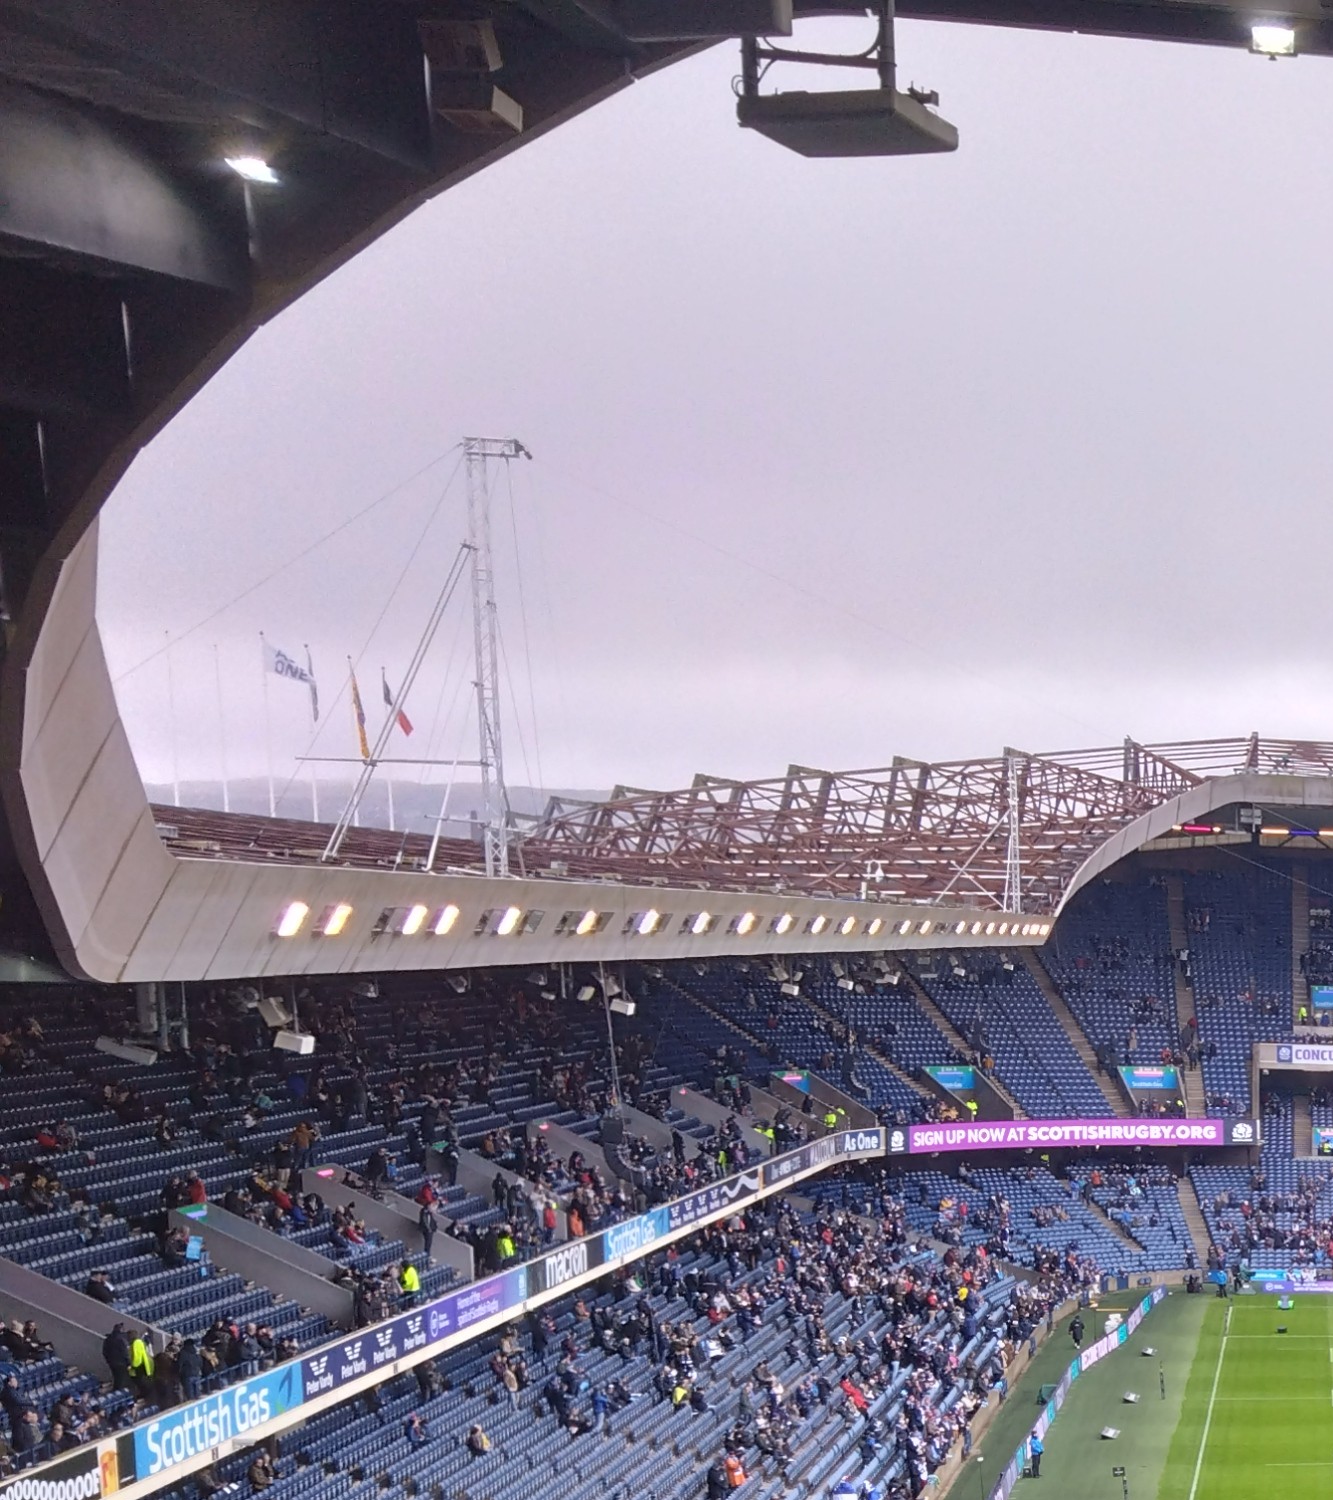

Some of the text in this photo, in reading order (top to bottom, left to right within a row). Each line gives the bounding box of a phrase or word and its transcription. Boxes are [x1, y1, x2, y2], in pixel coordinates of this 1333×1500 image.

[844, 1132, 879, 1151] As One
[913, 1123, 1217, 1148] SIGN UP NOW AT SCOTTISHRUGBY.ORG
[608, 1215, 656, 1260] Scottish Gas
[545, 1243, 588, 1288] macron
[373, 1345, 397, 1365] Peter Vardy
[341, 1359, 366, 1379] Peter Vardy
[306, 1371, 333, 1395] Peter Vardy
[146, 1386, 271, 1475] Scottish Gas
